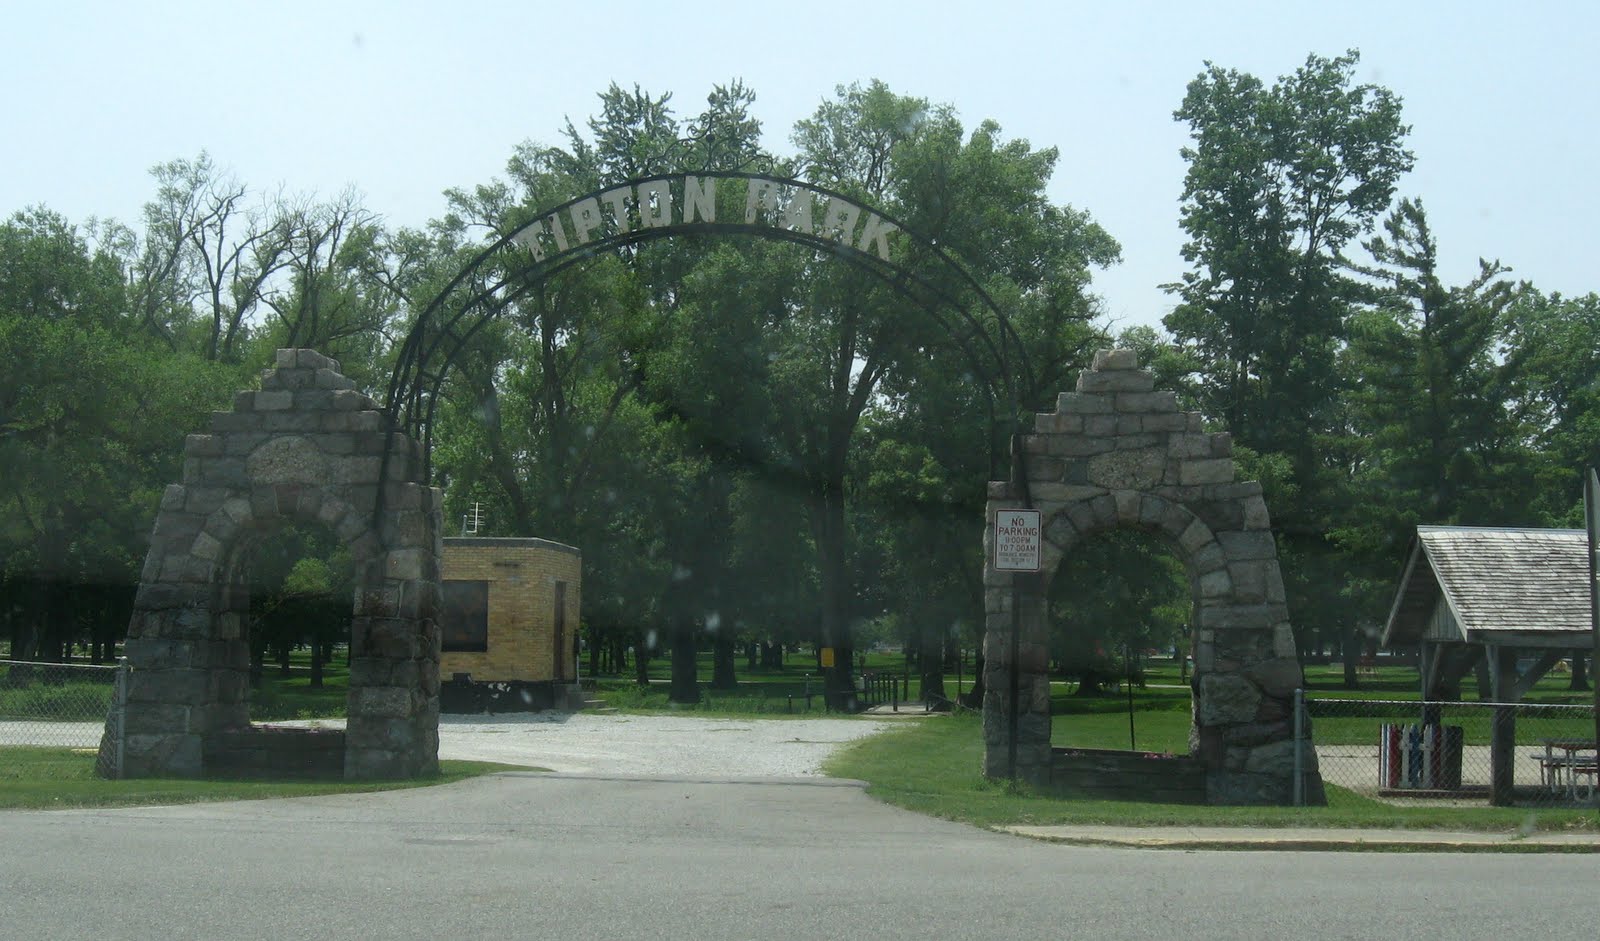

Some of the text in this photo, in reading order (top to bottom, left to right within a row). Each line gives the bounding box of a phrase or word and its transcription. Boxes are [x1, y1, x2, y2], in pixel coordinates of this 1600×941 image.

[512, 175, 900, 262] TIPTON PARK
[1011, 517, 1025, 526] NO
[998, 527, 1038, 536] PARKING
[1000, 544, 1009, 552] TO
